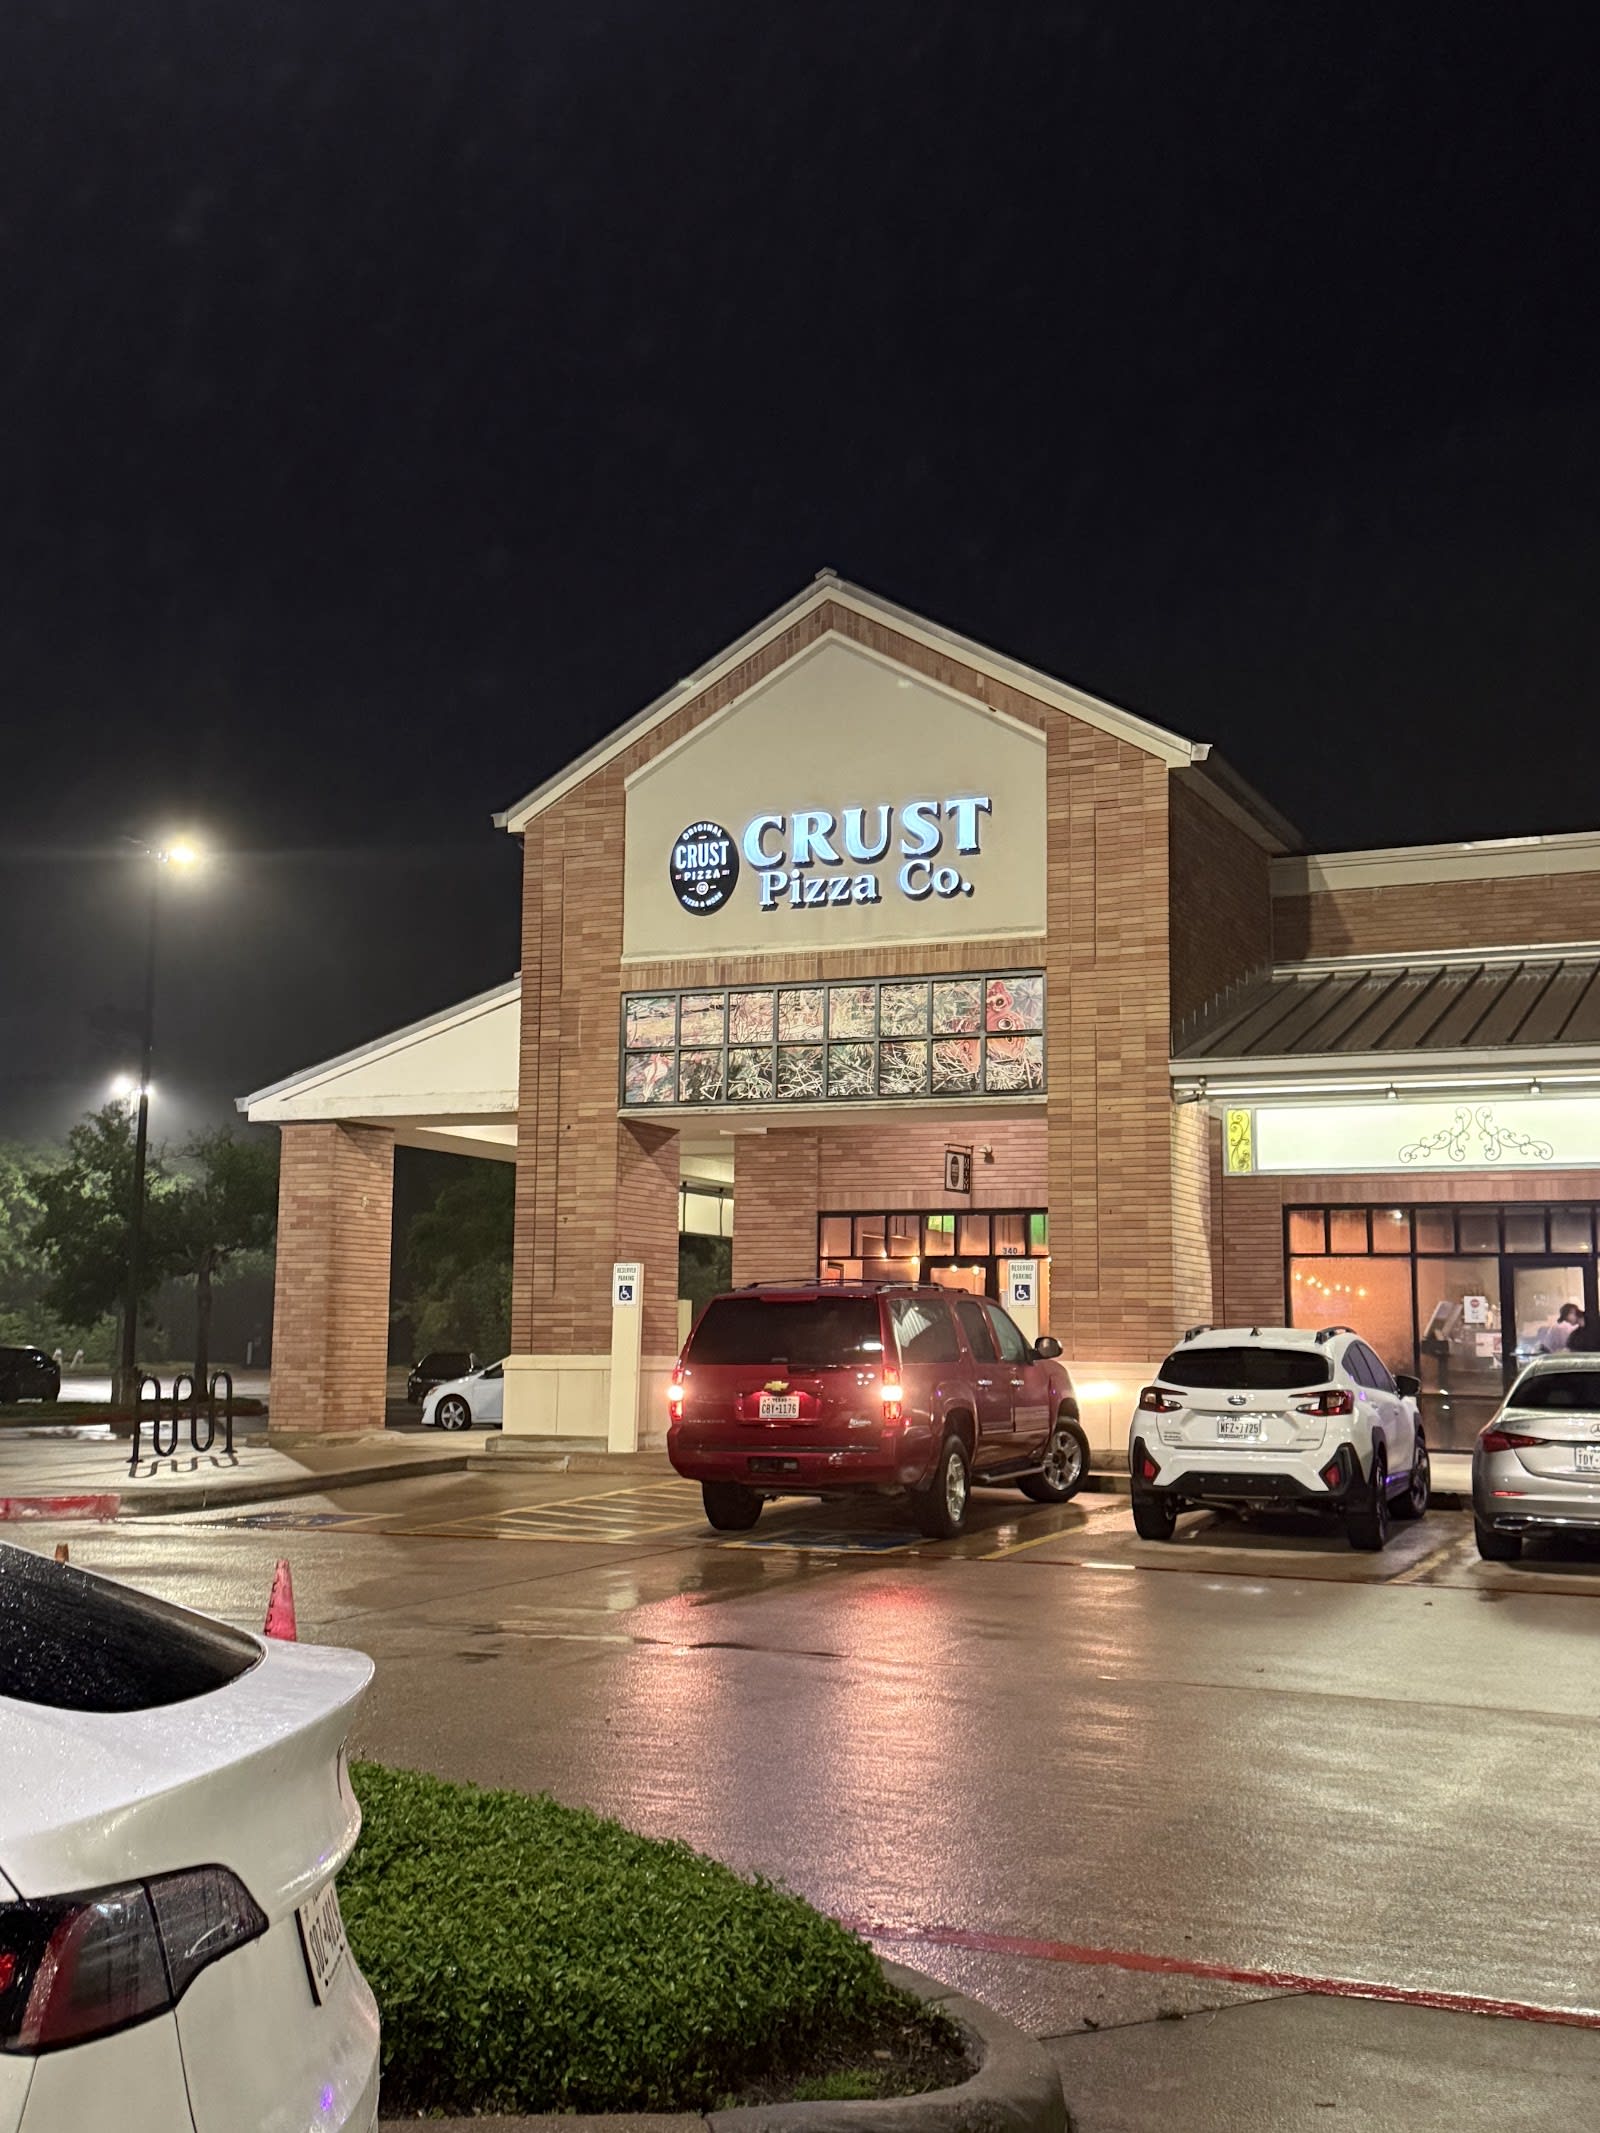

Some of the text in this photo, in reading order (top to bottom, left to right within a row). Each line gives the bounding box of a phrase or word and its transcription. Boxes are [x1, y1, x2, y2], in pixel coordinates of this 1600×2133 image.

[682, 824, 722, 841] ORIGINAL
[743, 797, 990, 868] CRUST
[675, 841, 729, 869] CRUST
[684, 869, 721, 881] PIZZA
[759, 858, 972, 907] Pizza Co.
[1002, 1247, 1018, 1255] 340
[1011, 1264, 1034, 1272] RESERVED
